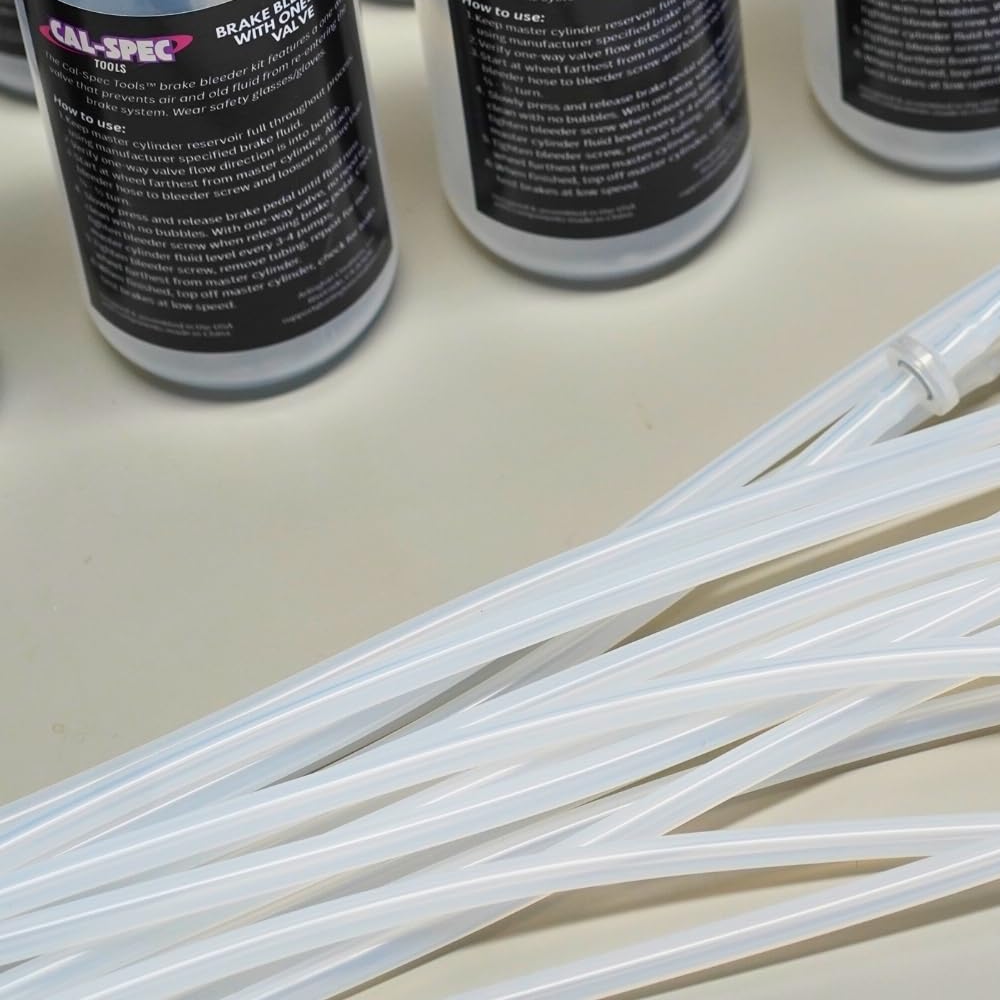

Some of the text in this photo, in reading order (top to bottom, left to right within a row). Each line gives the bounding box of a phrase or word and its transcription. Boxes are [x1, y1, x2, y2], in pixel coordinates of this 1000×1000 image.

[215, 7, 271, 39] BRAKE
[271, 4, 315, 43] VALVE
[495, 7, 510, 18] to
[513, 12, 545, 22] use:
[50, 19, 174, 63] CAL-SPEC
[234, 20, 276, 46] WITH
[62, 63, 111, 86] Cal-Spec
[159, 78, 196, 91] brake
[200, 66, 248, 87] bleeder
[251, 60, 265, 72] kit
[268, 32, 310, 65] features
[94, 59, 127, 74] TOOLS
[49, 67, 74, 85] valve
[76, 80, 98, 95] that
[102, 89, 156, 104] prevents
[159, 96, 176, 104] air
[180, 92, 205, 103] and
[209, 88, 229, 99] old
[232, 75, 260, 92] fluid
[262, 63, 289, 81] from
[53, 94, 126, 134] How to use:
[86, 95, 249, 118] brake system. Wear safety
[92, 130, 128, 146] master
[132, 140, 183, 151] cylinder
[187, 132, 244, 149] reservoir
[247, 124, 267, 137] full
[269, 87, 326, 129] throughout
[95, 143, 175, 164] manufacturer
[178, 146, 237, 164] specified
[240, 135, 274, 153] brake
[152, 165, 186, 176] valve
[188, 164, 216, 175] flow
[219, 149, 275, 171] direction
[288, 129, 309, 147] into
[236, 161, 277, 181] master
